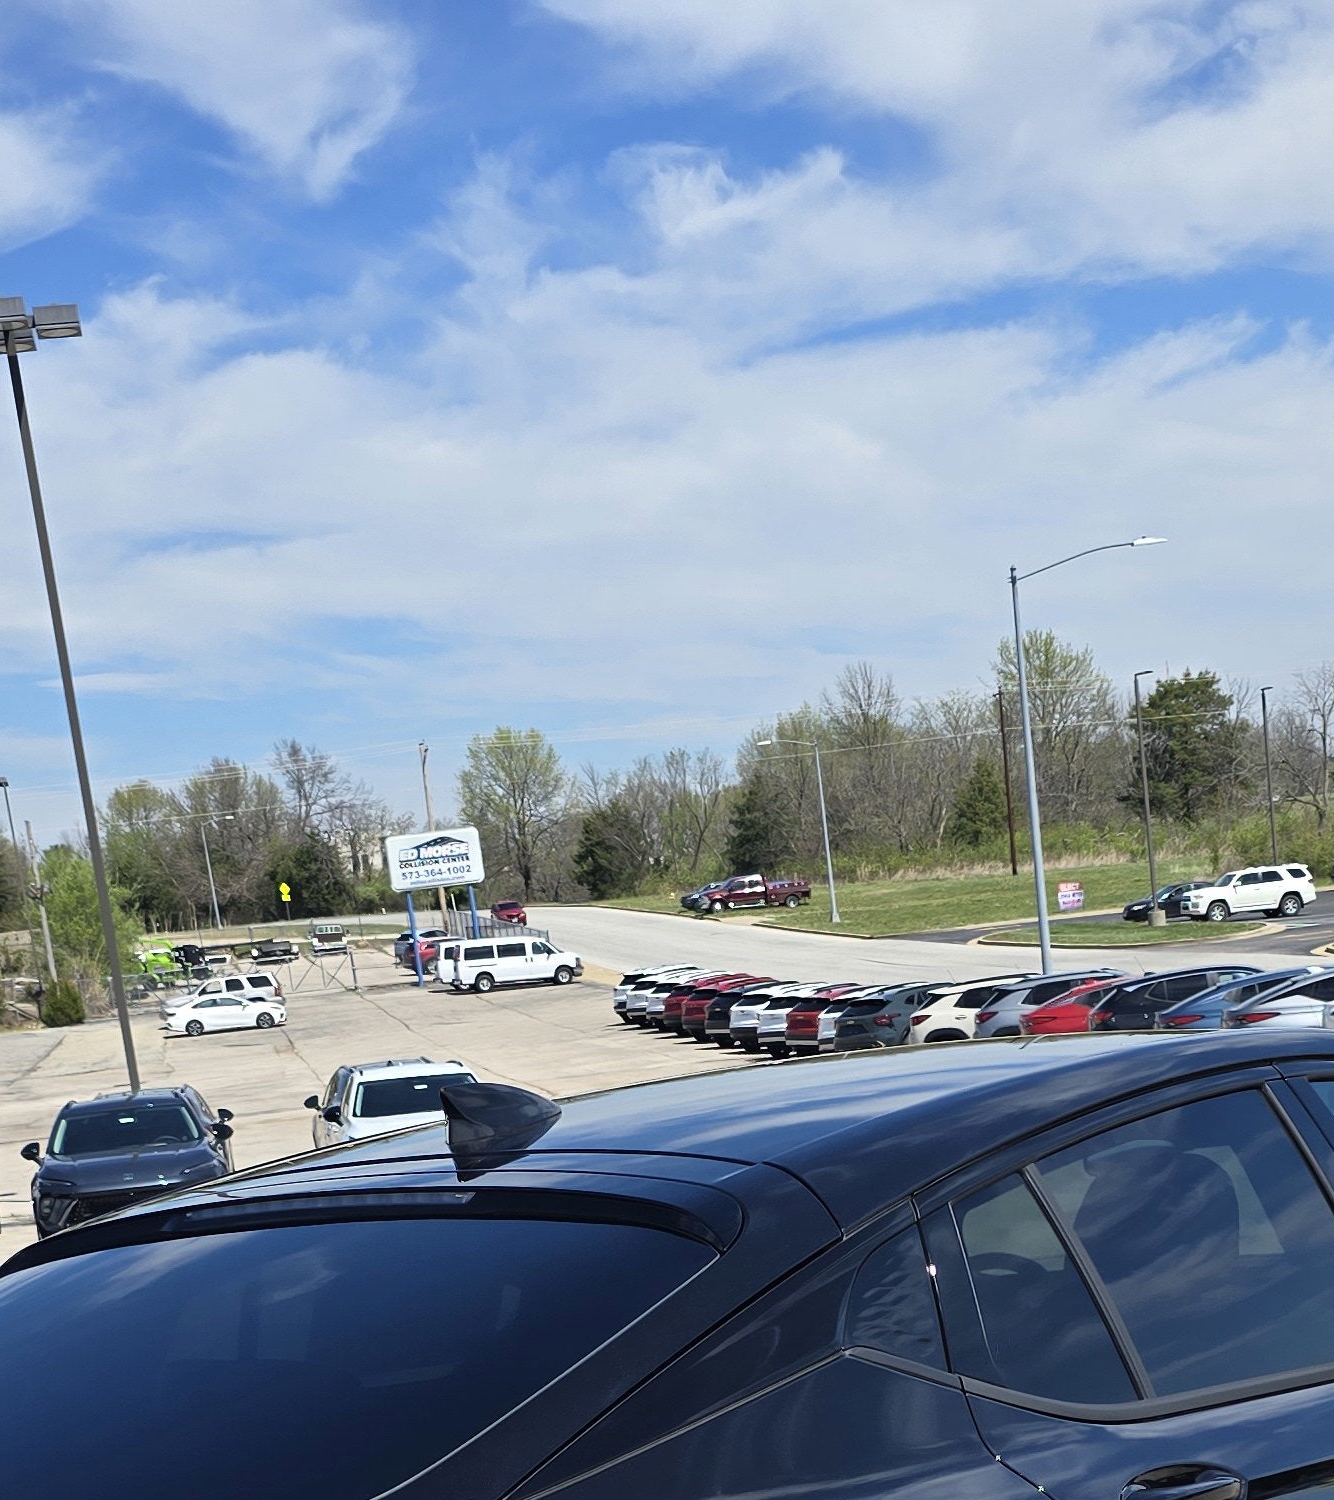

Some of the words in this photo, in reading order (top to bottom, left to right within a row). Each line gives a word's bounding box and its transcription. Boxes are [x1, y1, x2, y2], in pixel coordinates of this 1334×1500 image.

[399, 849, 418, 861] ED
[420, 842, 469, 859] MORSE
[399, 859, 440, 869] COLLISION
[401, 865, 472, 880] 573-364-1002
